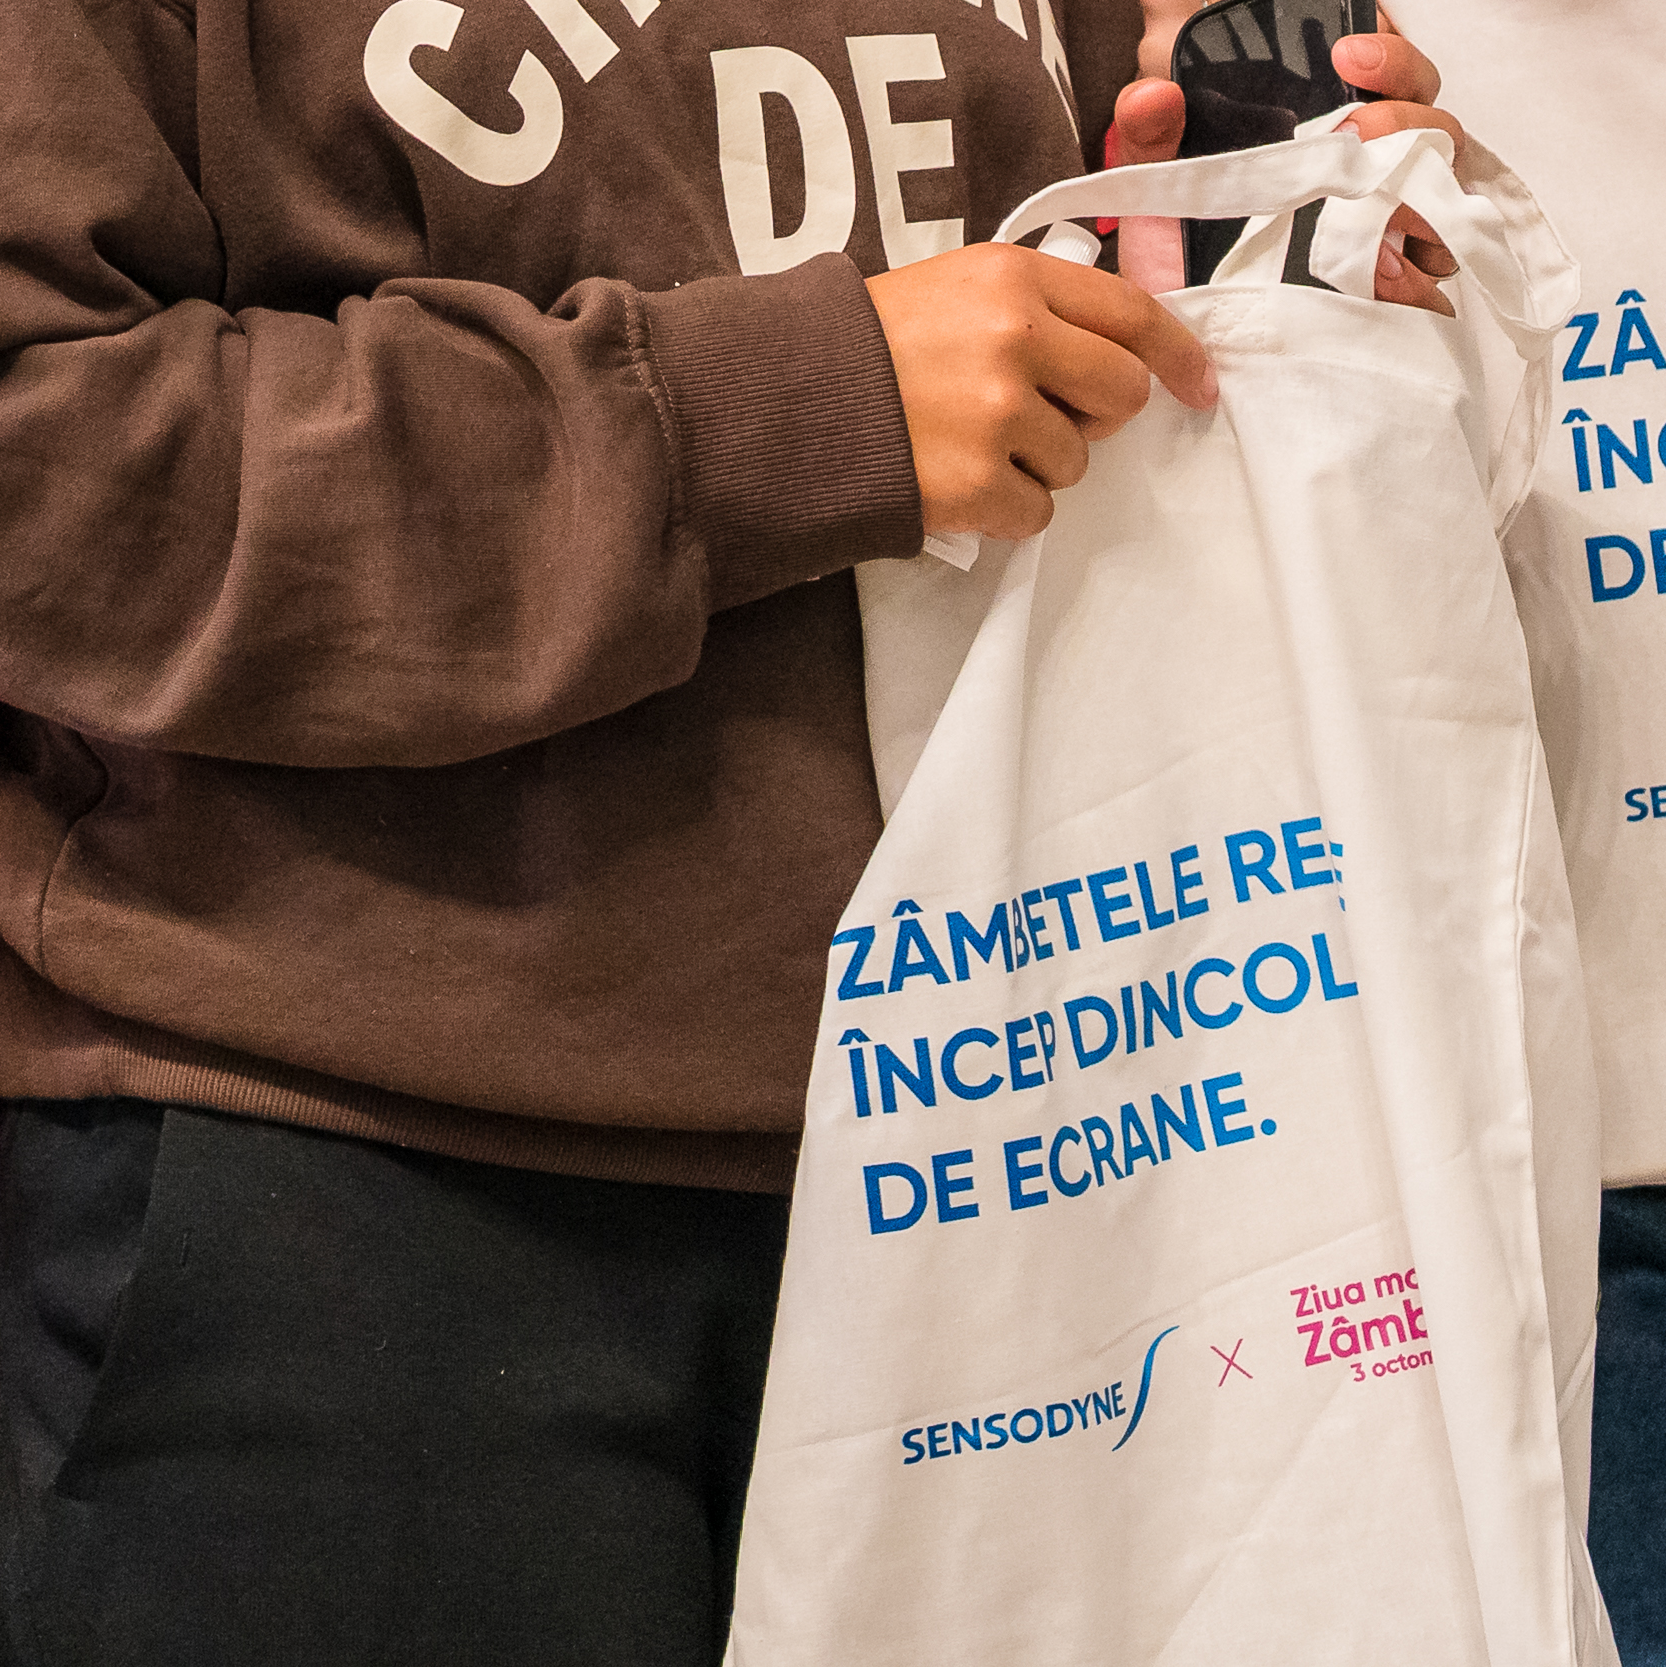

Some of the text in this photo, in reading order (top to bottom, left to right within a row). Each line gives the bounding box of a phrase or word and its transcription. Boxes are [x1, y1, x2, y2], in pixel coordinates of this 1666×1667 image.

[710, 33, 965, 276] DE
[831, 844, 1210, 1002] ZÂMBETELE
[837, 932, 1359, 1119] ÎNCEP DINCOL
[861, 1071, 1278, 1236] DE ECRANE.
[1290, 1283, 1366, 1318] Ziua
[1350, 1362, 1367, 1383] 3
[901, 1382, 1125, 1465] SENSODYNE
